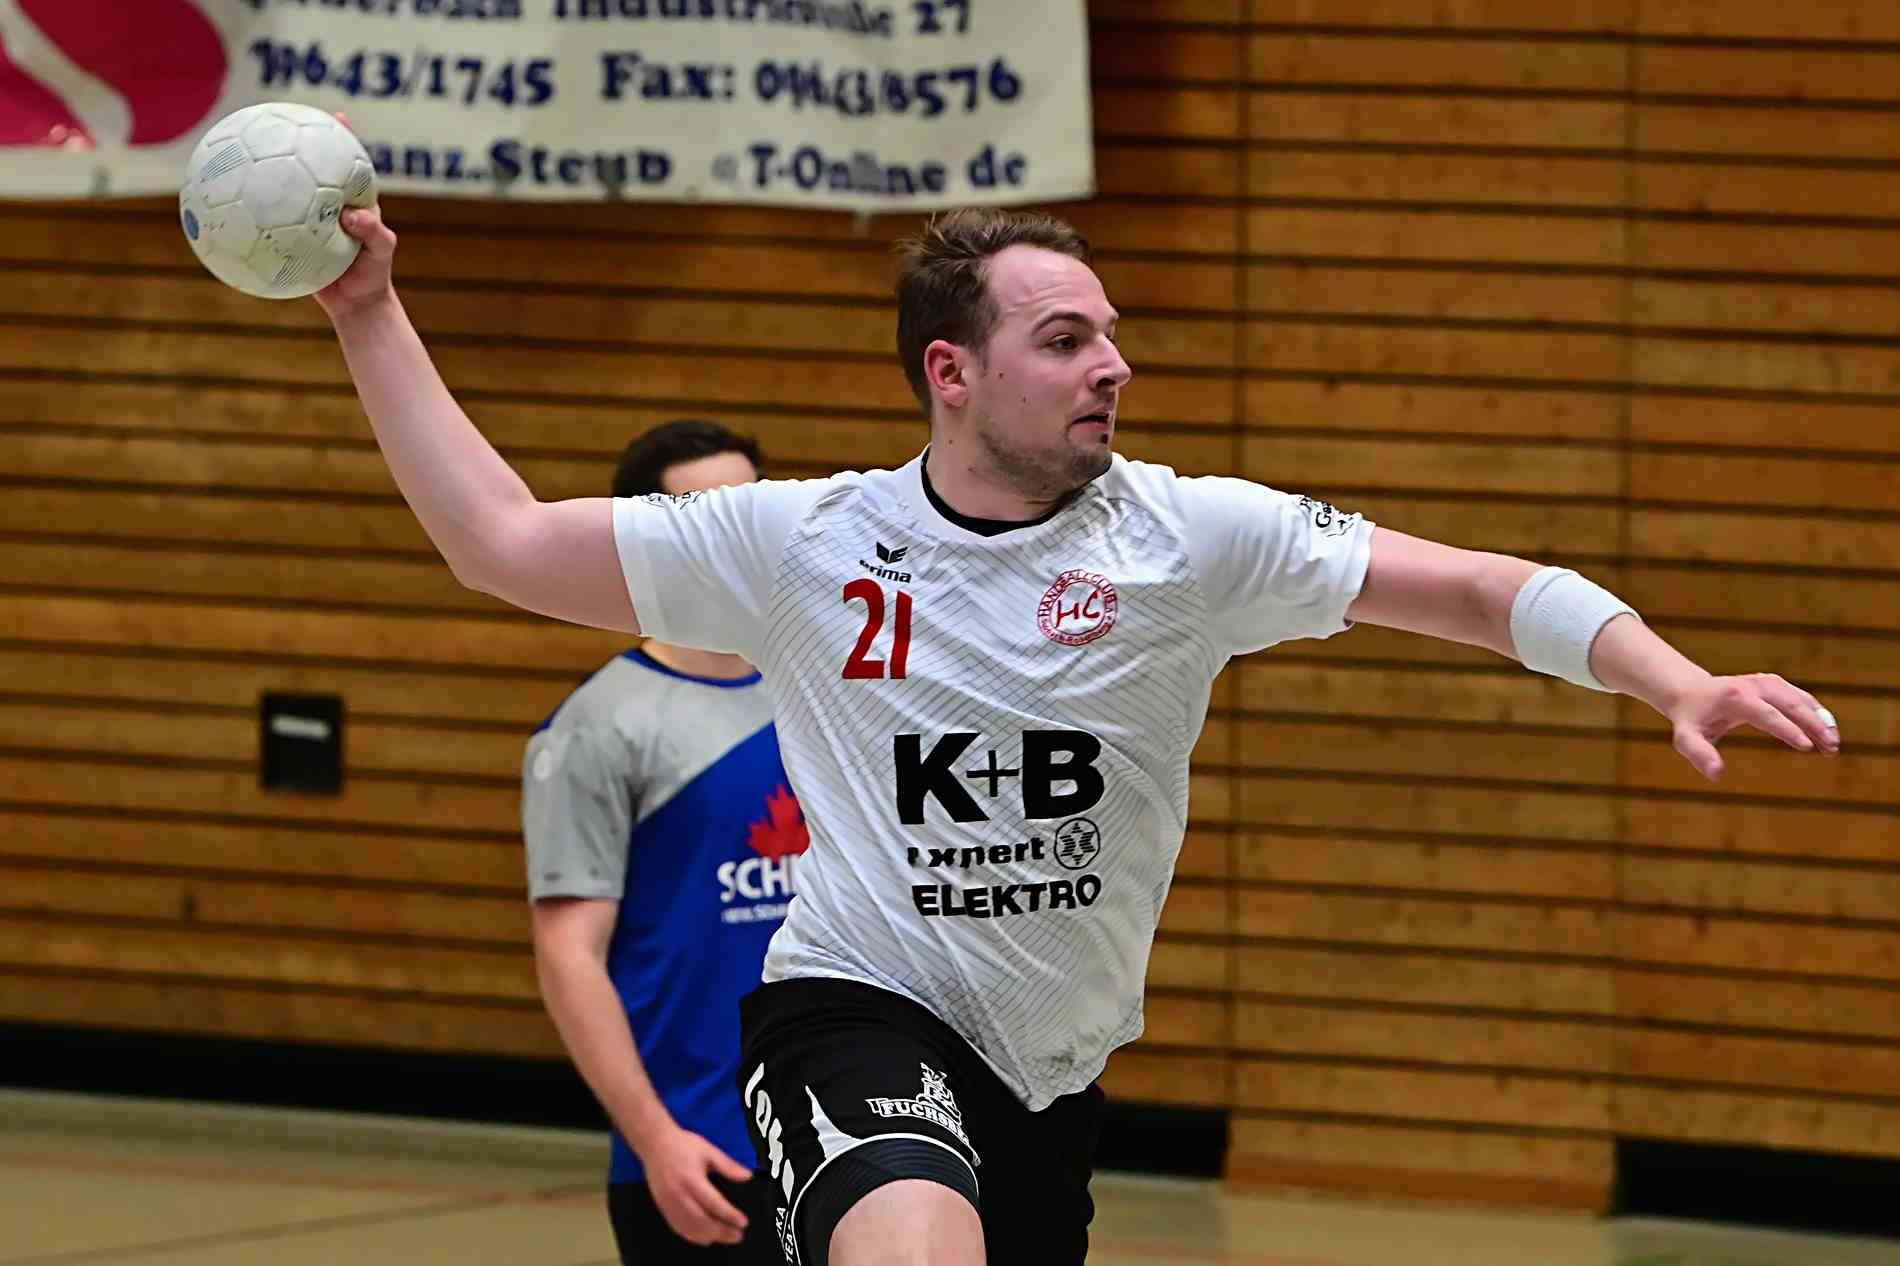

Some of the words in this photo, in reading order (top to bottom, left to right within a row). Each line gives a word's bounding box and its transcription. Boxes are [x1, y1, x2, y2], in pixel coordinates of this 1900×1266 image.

[599, 52, 734, 99] Fax:
[842, 578, 913, 680] 21
[894, 729, 1105, 825] K+B
[911, 873, 1102, 919] ELEKTRO
